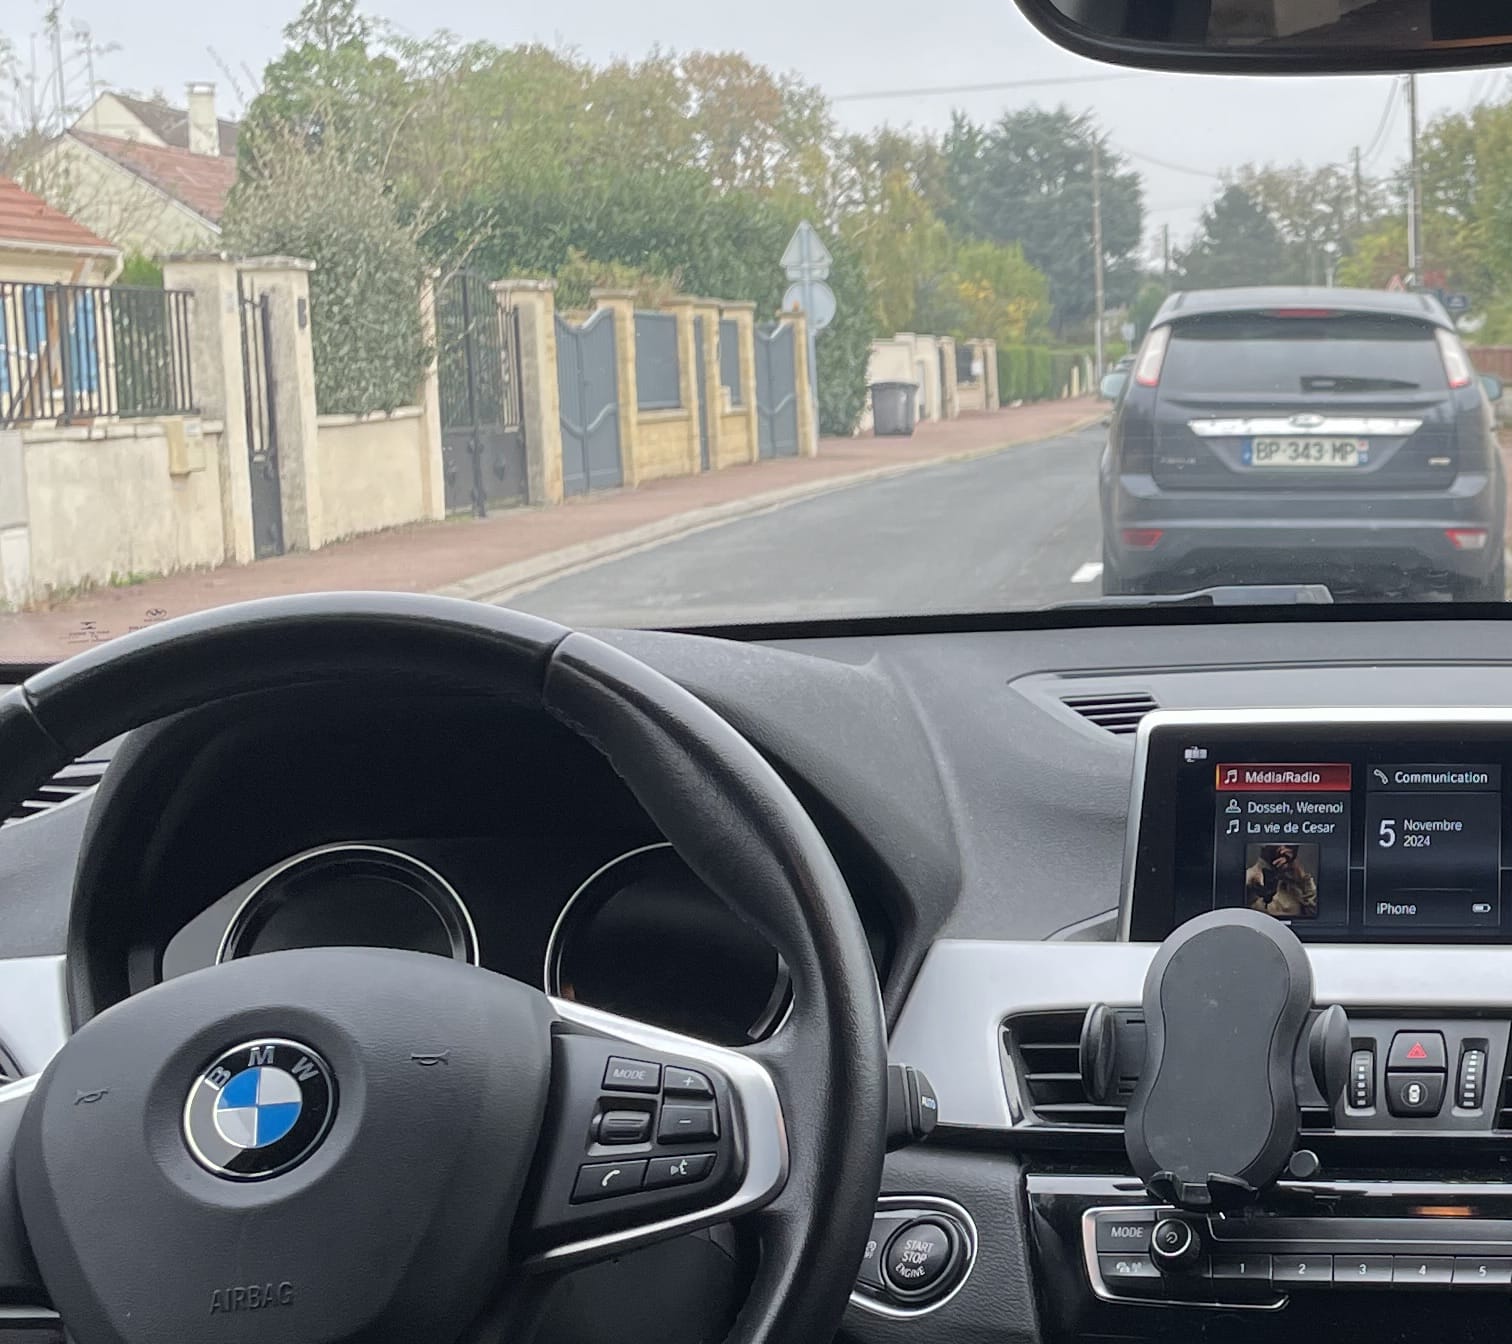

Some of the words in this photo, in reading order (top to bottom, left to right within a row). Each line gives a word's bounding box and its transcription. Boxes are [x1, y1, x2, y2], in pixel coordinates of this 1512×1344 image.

[1245, 770, 1321, 784] Média/Radio
[1395, 771, 1488, 784] Communication
[1247, 801, 1293, 815] Dosseh,
[1296, 801, 1344, 814] Werenoi
[1247, 821, 1261, 834] La
[1263, 821, 1281, 834] vie
[1283, 821, 1299, 834] de
[1301, 821, 1336, 834] Cesar
[1403, 818, 1463, 832] Novembre
[1379, 820, 1396, 848] 5
[1403, 835, 1431, 848] 2024
[1376, 902, 1417, 916] iPhone
[204, 1045, 320, 1091] BMW
[613, 1068, 647, 1081] MODE
[1110, 1226, 1144, 1239] MODE
[904, 1239, 934, 1253] START
[902, 1251, 928, 1264] STOP
[895, 1262, 926, 1278] ENGINE
[1298, 1263, 1307, 1275] 2
[1358, 1263, 1367, 1275] 3
[1418, 1264, 1427, 1276] 4
[1479, 1265, 1488, 1277] 5
[209, 1281, 293, 1315] AIRBAG
